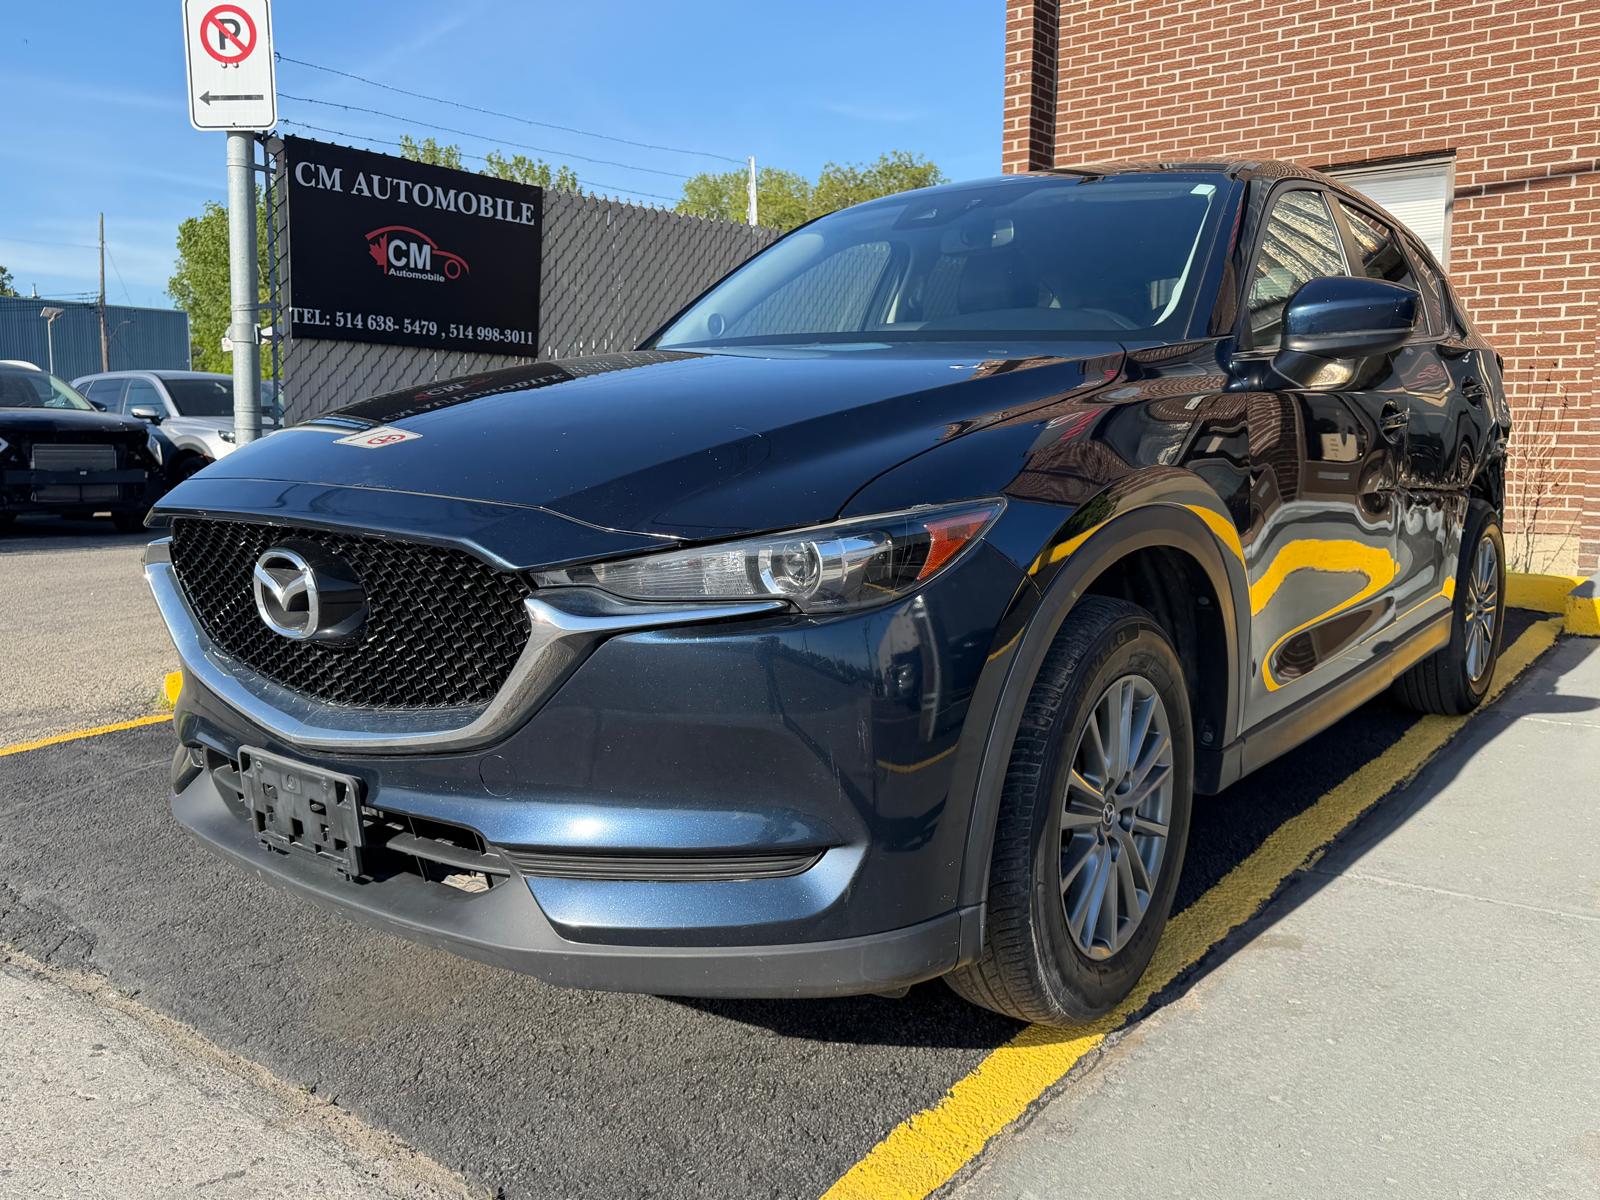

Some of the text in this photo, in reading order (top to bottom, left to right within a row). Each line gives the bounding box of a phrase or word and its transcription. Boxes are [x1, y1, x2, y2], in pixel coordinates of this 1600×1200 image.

[218, 18, 241, 50] P
[295, 161, 535, 226] CM AUTOMOBILE
[388, 239, 431, 270] CM
[388, 268, 445, 282] Automobile
[291, 307, 330, 326] TEL:
[335, 311, 363, 329] 514
[403, 318, 438, 335] 5479
[449, 323, 474, 340] 514
[477, 326, 533, 345] 998-3011
